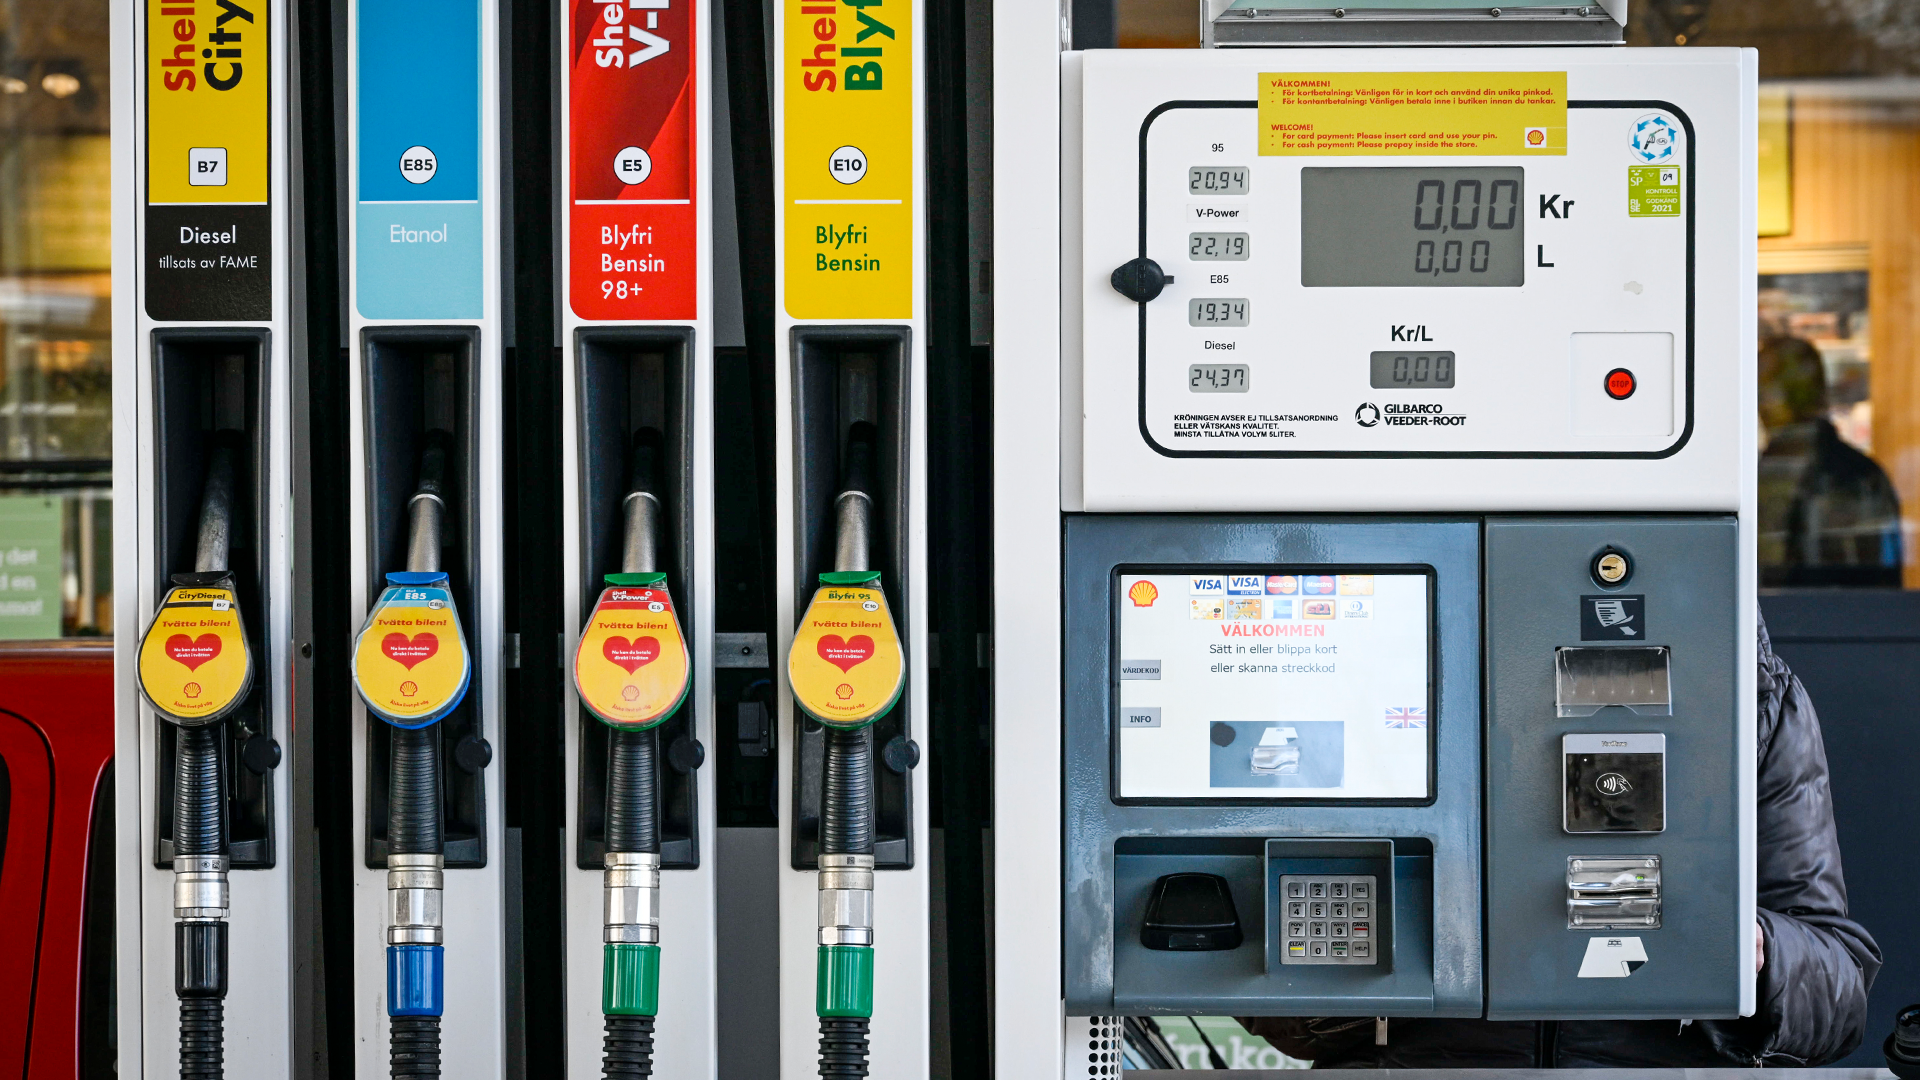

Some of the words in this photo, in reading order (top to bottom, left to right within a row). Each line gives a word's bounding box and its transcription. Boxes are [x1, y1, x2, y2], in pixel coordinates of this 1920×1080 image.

[593, 0, 624, 68] She
[1271, 78, 1331, 88] VÄLKOMMEN!
[1298, 89, 1353, 98] kortbetalning:
[1355, 89, 1390, 98] Vänligen
[1523, 88, 1553, 97] pinkod.
[1298, 98, 1367, 106] kontantbetalning:
[1370, 98, 1404, 106] Vänligen
[1316, 132, 1354, 141] payment:
[1482, 132, 1498, 140] pin.
[1211, 143, 1224, 152] 95
[1317, 142, 1354, 150] payment:
[197, 160, 218, 173] B7
[403, 159, 433, 171] E85
[622, 159, 642, 172] E5
[833, 158, 863, 172] E10
[1191, 171, 1244, 191] 20,94
[1630, 176, 1643, 186] SP
[1196, 208, 1240, 218] V-Power
[1414, 180, 1519, 234] 0,00
[1540, 194, 1575, 219] Kr
[180, 225, 236, 243] Diesel
[390, 223, 447, 243] Etanol
[601, 224, 652, 251] Blyfri
[816, 224, 867, 250] Blyfri
[1191, 237, 1244, 257] 22,19
[159, 255, 196, 269] tillsats
[200, 259, 216, 269] av
[220, 255, 258, 269] FAME
[601, 253, 665, 272] Bensin
[816, 253, 880, 272] Bensin
[1414, 240, 1490, 277] 0,00
[1537, 244, 1555, 268] L
[1210, 274, 1229, 284] E85
[600, 280, 643, 300] 98+
[1197, 303, 1244, 322] 19,34
[1391, 325, 1434, 342] Kr/L
[1204, 340, 1236, 350] Diesel
[1392, 356, 1451, 386] 0,00
[1192, 369, 1244, 388] 24,37
[1384, 404, 1443, 414] GILBARCO
[1174, 414, 1219, 422] KRÖNINGEN
[1384, 416, 1467, 426] VEEDER-ROOT
[1204, 430, 1240, 438] TILLÅTNA
[1193, 579, 1222, 590] VISA
[1232, 577, 1260, 588] VISA
[1220, 622, 1325, 637] VÄLKOMMEN
[1209, 644, 1232, 654] Sätt
[1236, 644, 1246, 654] in
[1250, 644, 1274, 654] eller
[1277, 644, 1311, 656] blippa
[1315, 644, 1338, 654] kort
[1122, 666, 1160, 674] VÄRDEKOD
[1210, 662, 1234, 673] eller
[1238, 662, 1278, 673] skanna
[1282, 662, 1336, 673] streckkod
[1130, 715, 1152, 723] INFO
